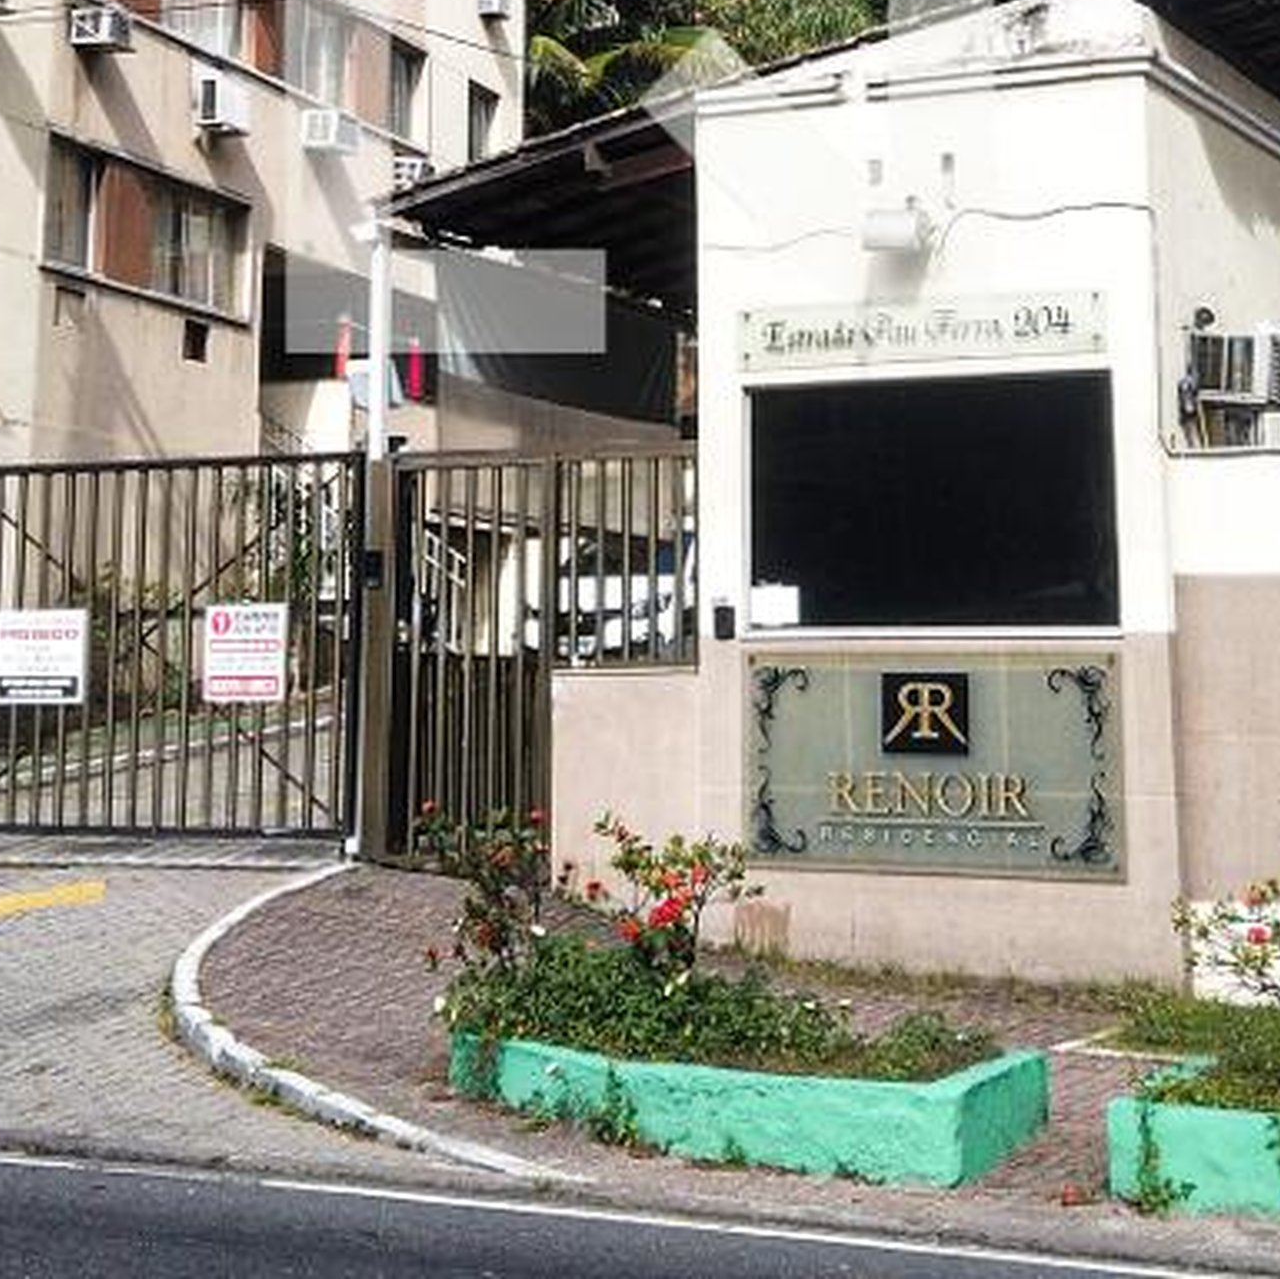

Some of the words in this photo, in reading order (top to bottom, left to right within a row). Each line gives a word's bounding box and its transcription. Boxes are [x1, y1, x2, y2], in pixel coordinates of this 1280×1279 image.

[1013, 304, 1071, 338] 204
[827, 771, 1031, 819] RENOIR
[819, 824, 1040, 850] RESIDENCAL
